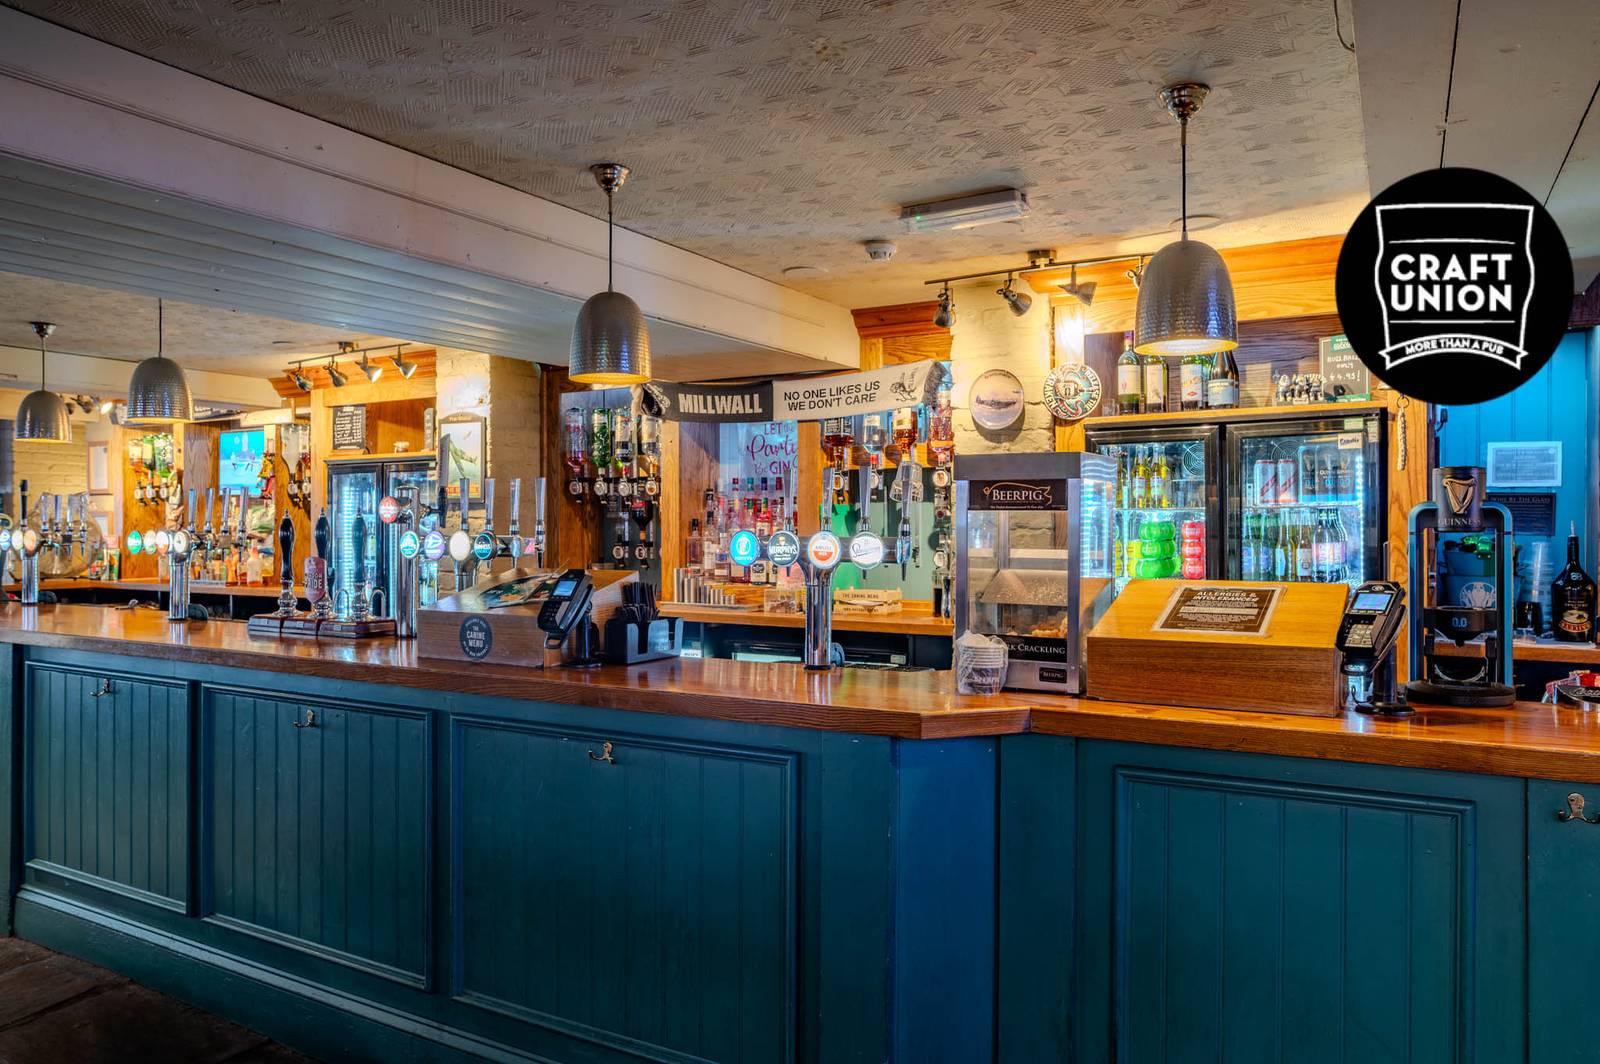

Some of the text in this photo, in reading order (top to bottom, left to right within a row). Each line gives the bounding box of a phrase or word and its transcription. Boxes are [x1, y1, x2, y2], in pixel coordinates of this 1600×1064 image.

[784, 381, 880, 401] NO ONE LIKES US
[678, 393, 763, 414] MILLWALL
[788, 392, 876, 411] WE DON'T CARE
[764, 422, 782, 435] LET
[992, 489, 1043, 501] BEERPIG
[1452, 617, 1467, 628] 0.0
[1018, 643, 1065, 654] CRACKLING
